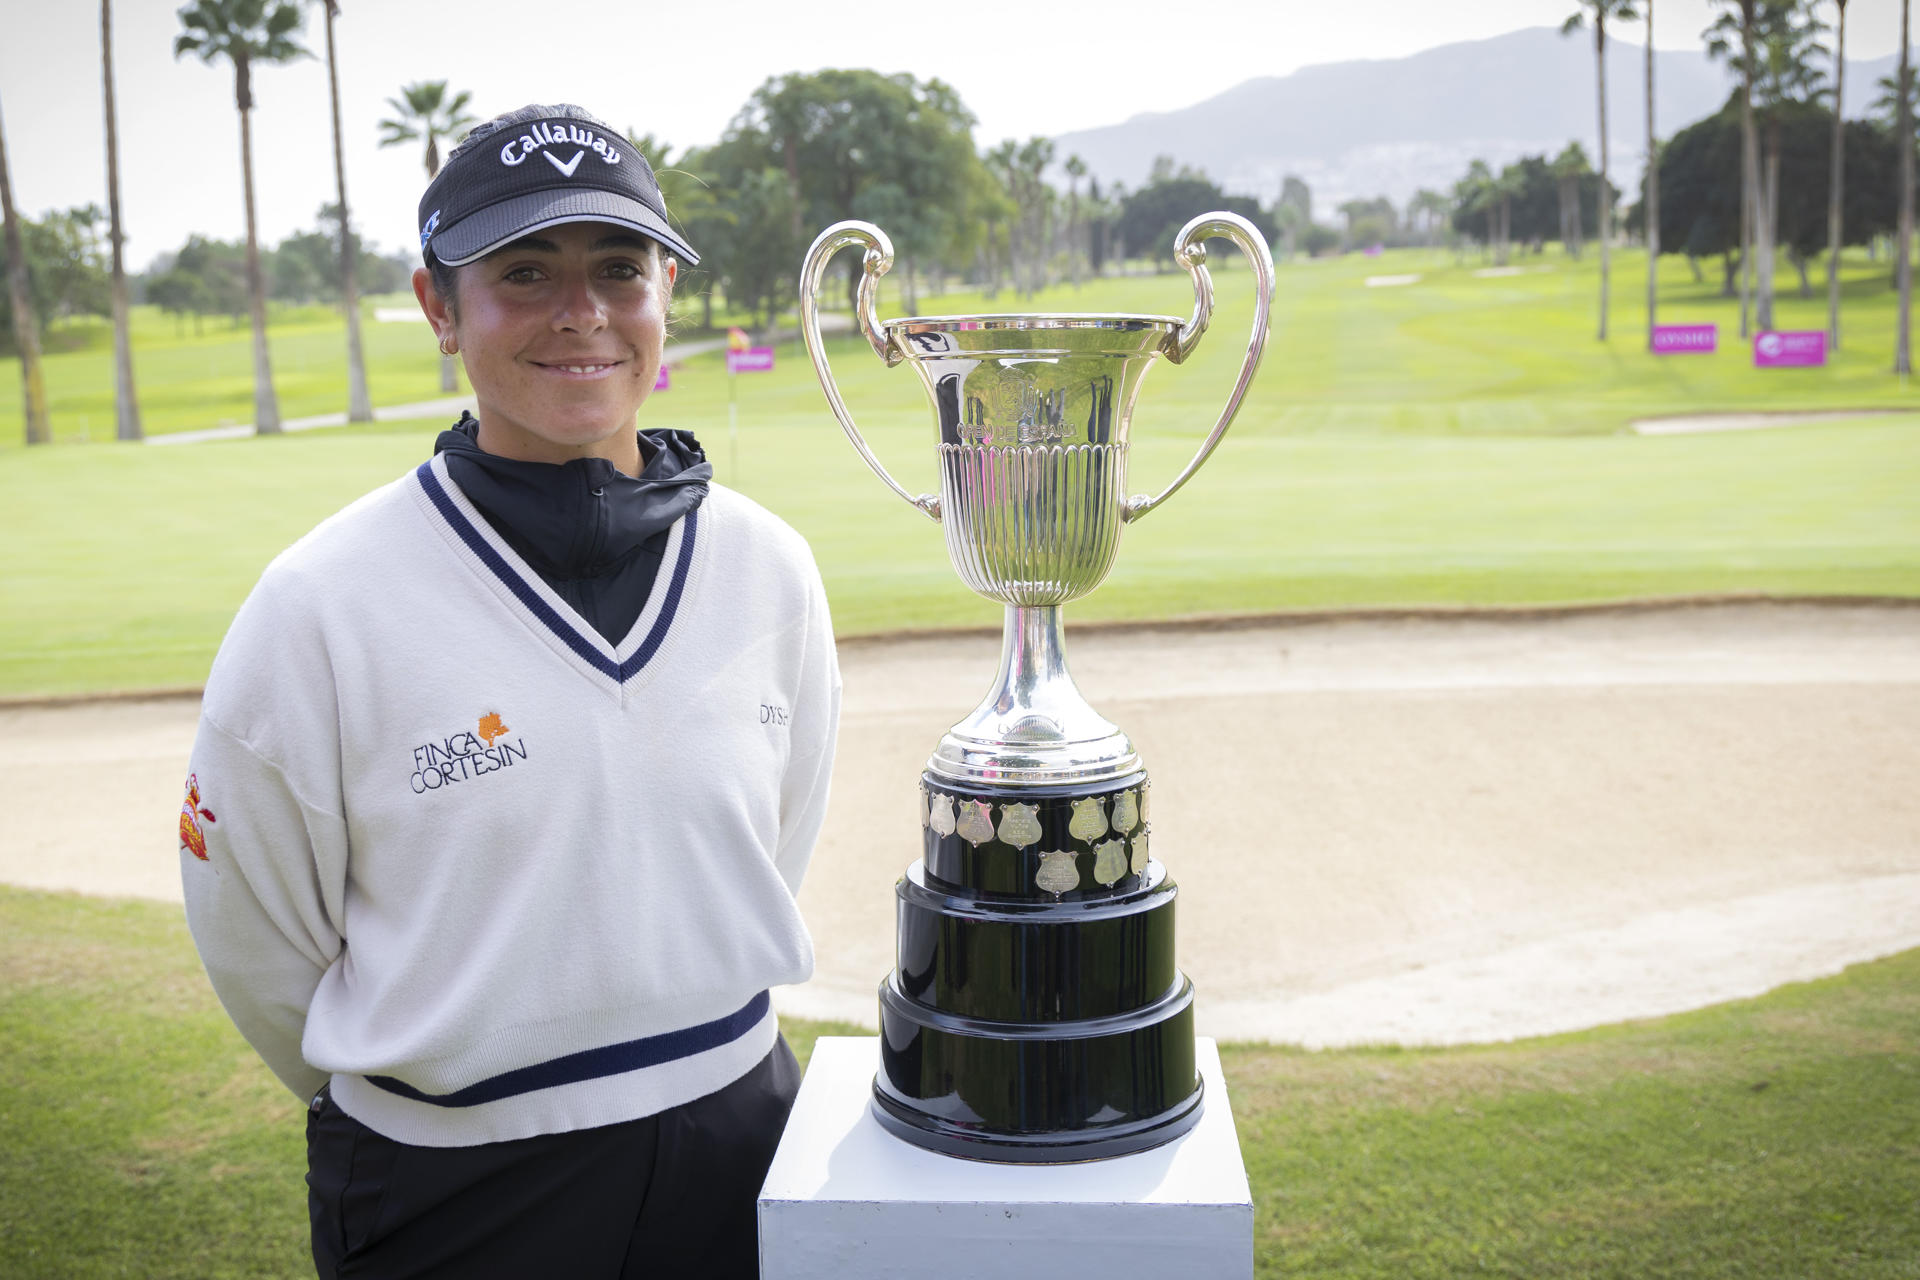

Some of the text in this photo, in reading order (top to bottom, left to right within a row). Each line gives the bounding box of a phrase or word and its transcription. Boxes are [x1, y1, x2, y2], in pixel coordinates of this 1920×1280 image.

[501, 122, 620, 166] Callaway
[956, 422, 994, 441] OPEN
[995, 424, 1017, 443] DE
[410, 738, 527, 794] CORTESIN
[414, 731, 483, 771] FINCA
